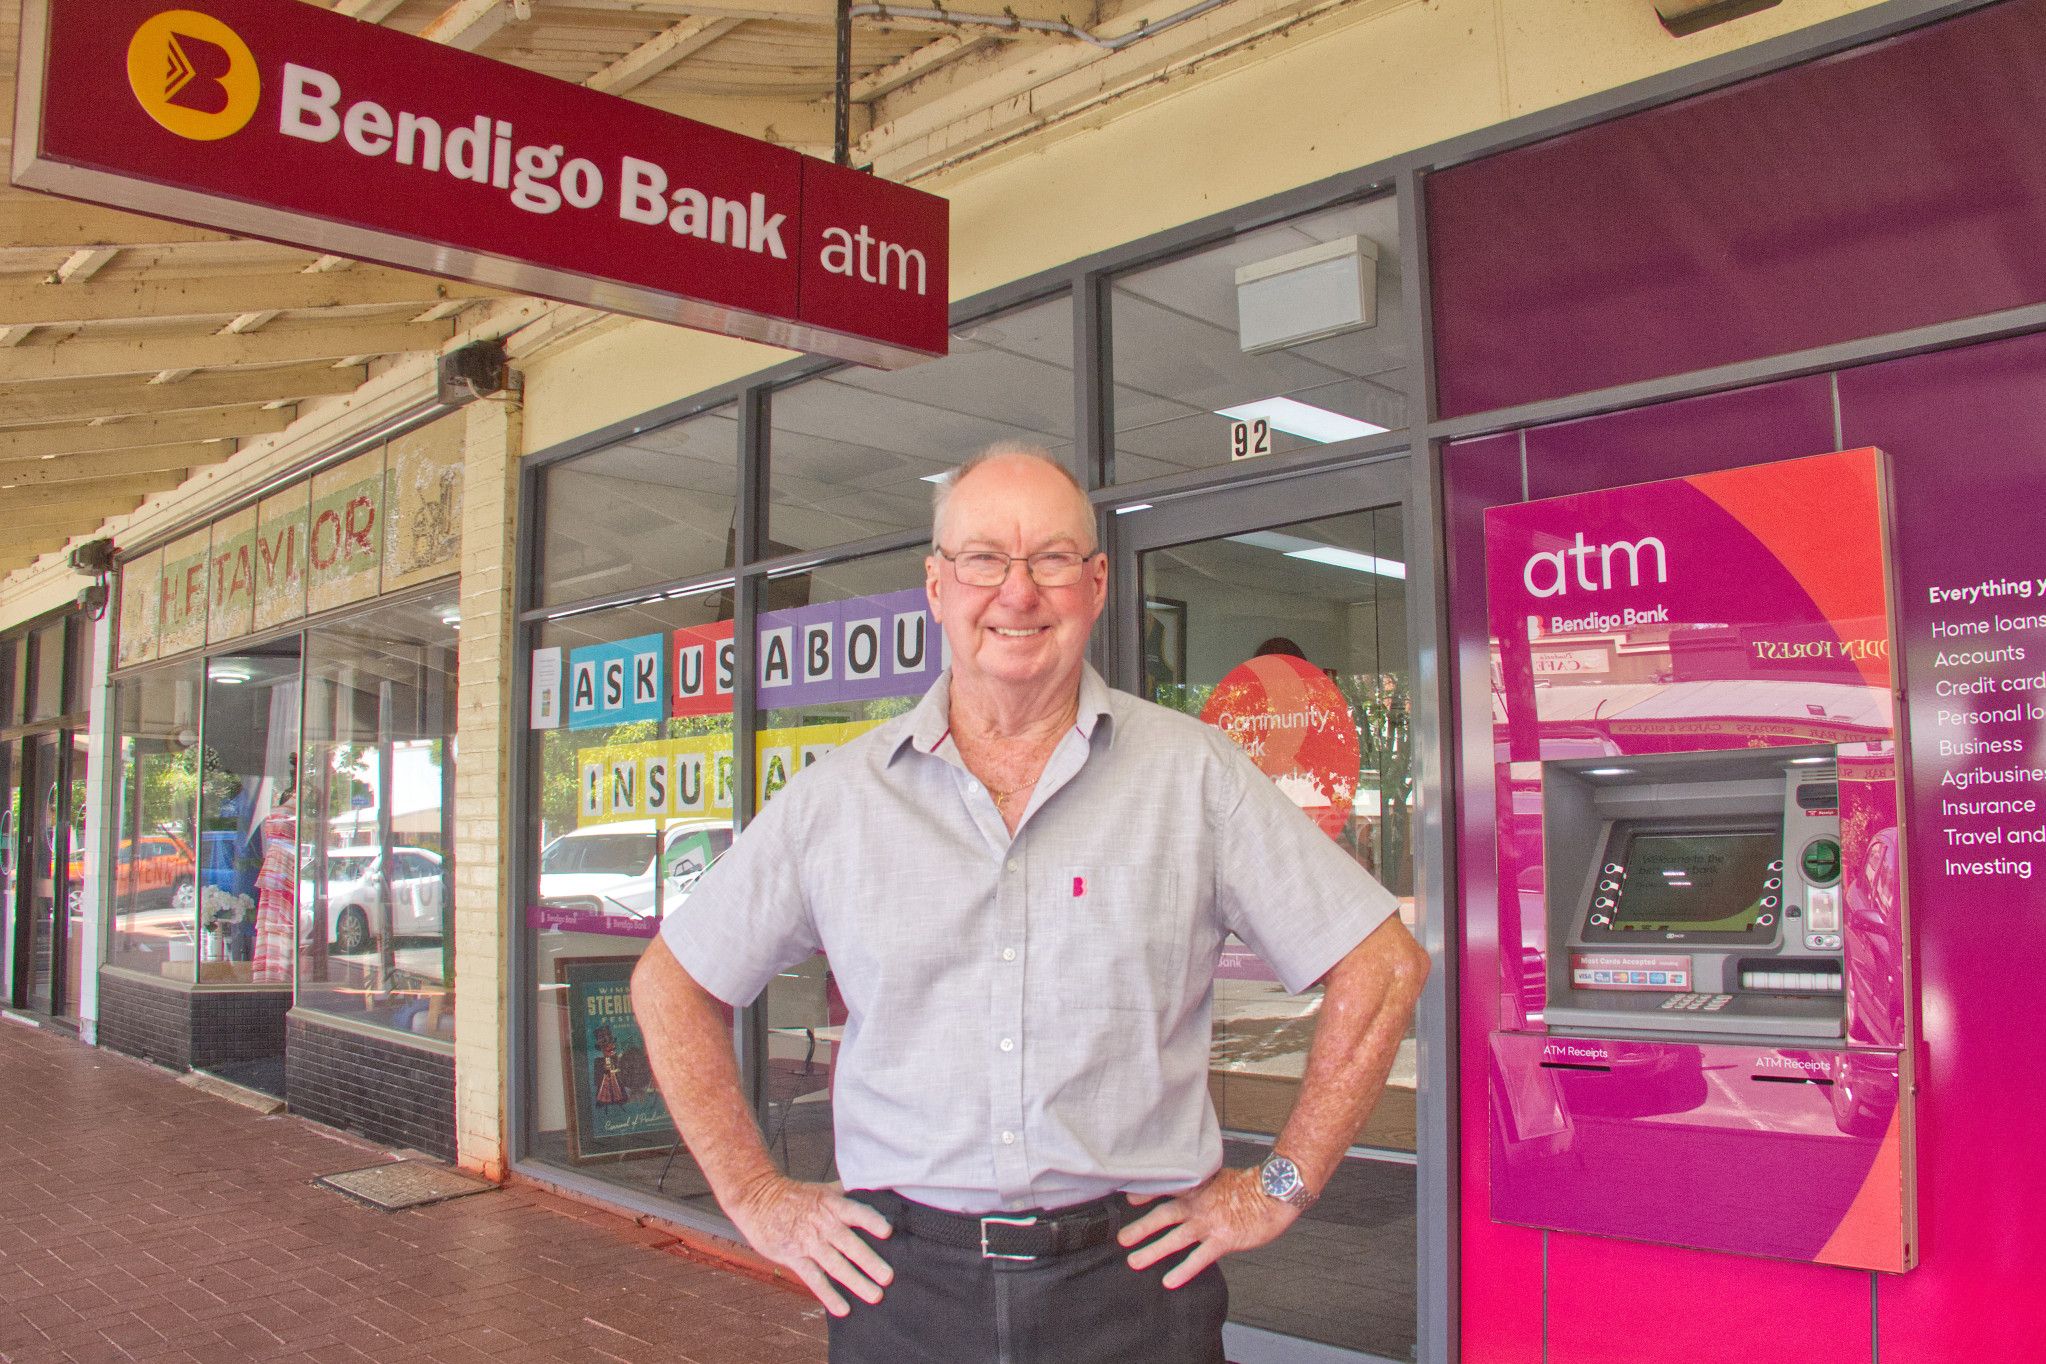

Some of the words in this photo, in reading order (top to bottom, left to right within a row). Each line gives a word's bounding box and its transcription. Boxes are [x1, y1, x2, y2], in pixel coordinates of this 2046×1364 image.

[279, 61, 603, 216] Bendigo
[619, 156, 788, 261] Bank
[819, 224, 928, 296] atm
[1234, 419, 1268, 457] 92
[211, 494, 376, 607] TAYLOR
[1523, 531, 1667, 599] atm
[1929, 578, 2032, 605] Everything
[1551, 611, 1621, 634] Bendigo
[1623, 603, 1669, 626] Bank
[1931, 620, 1989, 639] Home
[1995, 614, 2046, 633] loans
[574, 652, 656, 708] ASK
[679, 643, 734, 696] US
[765, 616, 925, 682] ABOU
[1934, 645, 2025, 668] Accounts
[1935, 676, 1996, 699] Credit
[2001, 671, 2046, 692] card
[1218, 705, 1330, 733] Community
[1937, 703, 2022, 726] Personal
[2028, 703, 2046, 721] lo
[1939, 736, 2023, 756] Business
[590, 749, 830, 810] INSURA
[1942, 799, 2036, 816] Insurance
[1944, 826, 2002, 846] Travel
[2007, 825, 2046, 843] and
[1945, 858, 2032, 878] Investing
[1543, 1045, 1566, 1057] ATM
[1567, 1046, 1608, 1060] Receipts
[1755, 1057, 1782, 1068] ATM
[1783, 1058, 1831, 1072] Receipts
